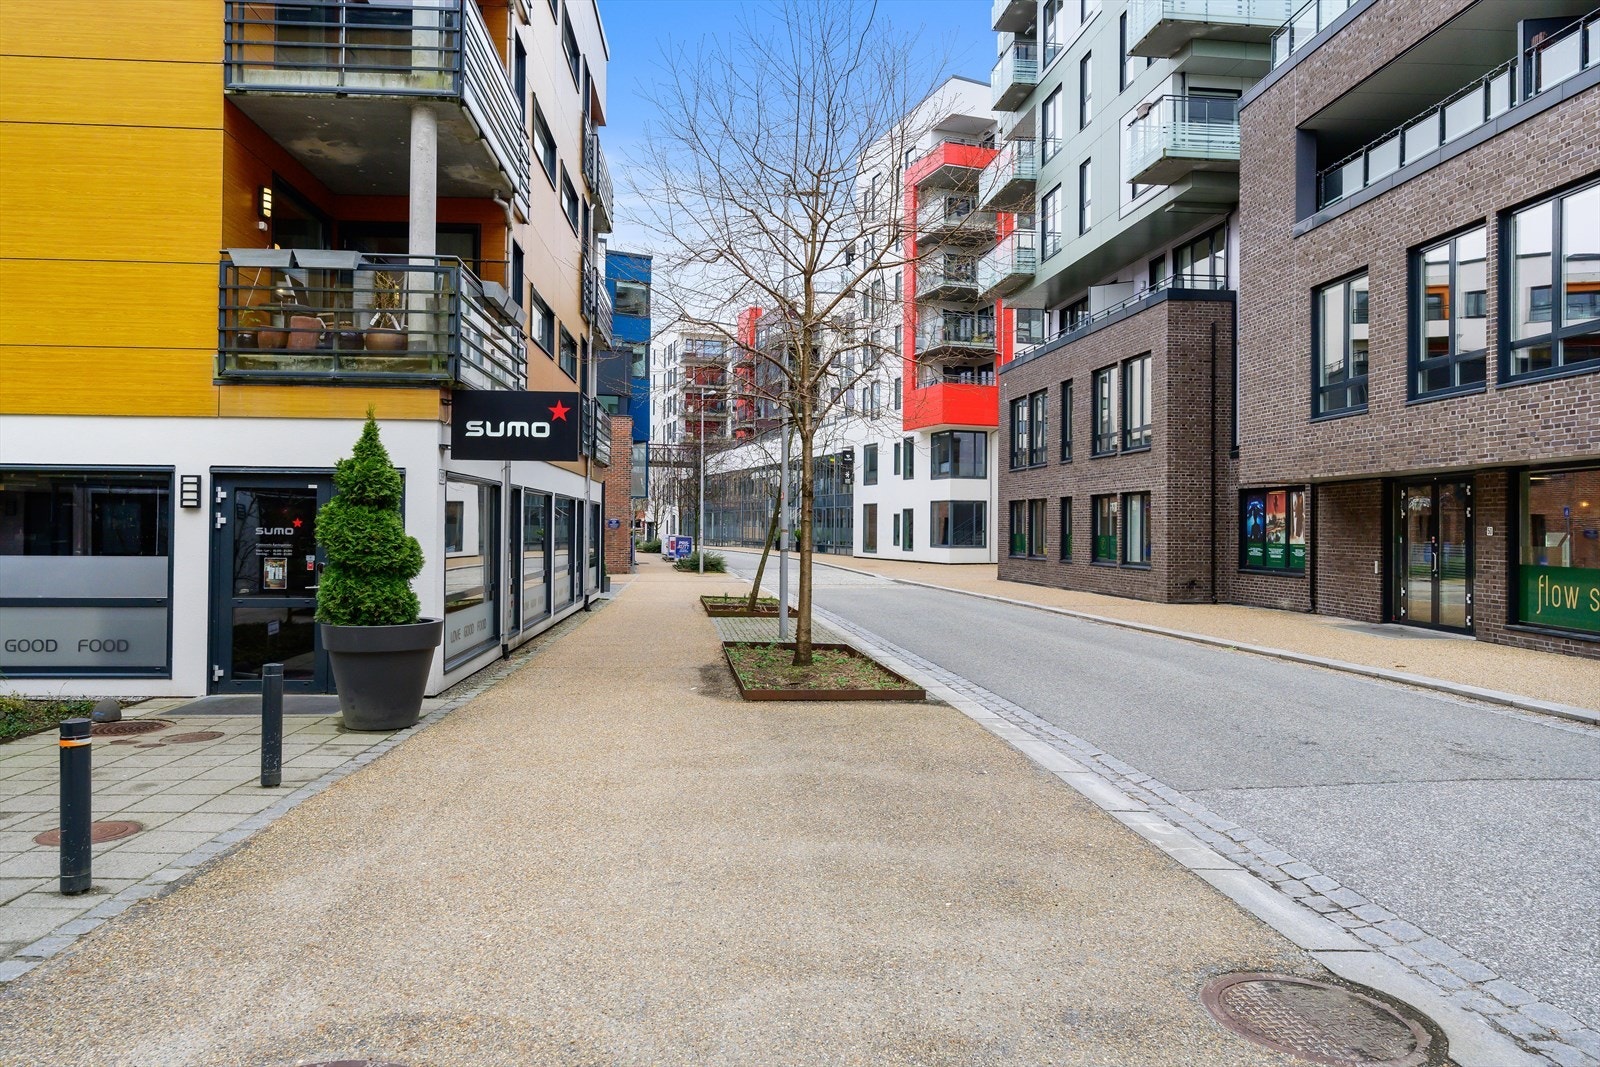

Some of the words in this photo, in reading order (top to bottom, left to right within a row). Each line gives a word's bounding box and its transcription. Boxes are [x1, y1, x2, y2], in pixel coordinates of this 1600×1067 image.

[465, 420, 551, 438] SUMO
[255, 527, 294, 536] SUMO
[1536, 574, 1580, 615] flow
[450, 627, 462, 644] LOVE
[463, 622, 475, 638] GOOD
[476, 617, 487, 631] FOOD
[4, 639, 58, 653] GOOD
[77, 639, 129, 653] FOOD
